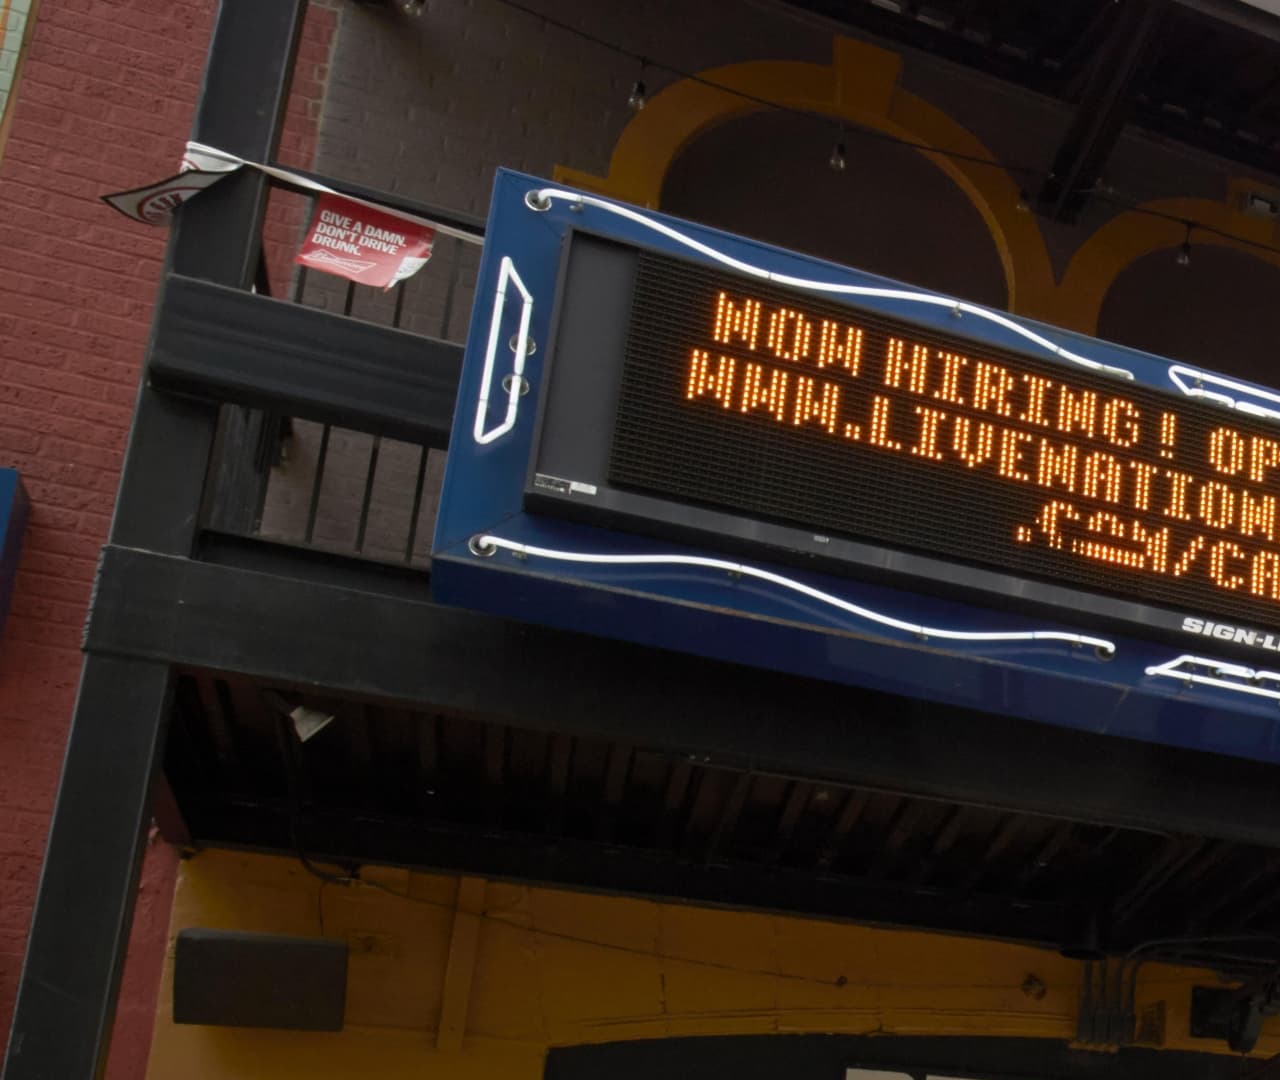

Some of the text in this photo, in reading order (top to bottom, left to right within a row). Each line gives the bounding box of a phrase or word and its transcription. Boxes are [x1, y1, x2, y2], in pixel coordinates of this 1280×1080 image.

[312, 233, 362, 256] DRUNK.
[316, 222, 399, 255] DON'T DRIVE
[320, 209, 407, 247] GIVE A DAMN.
[714, 292, 863, 377] NOW
